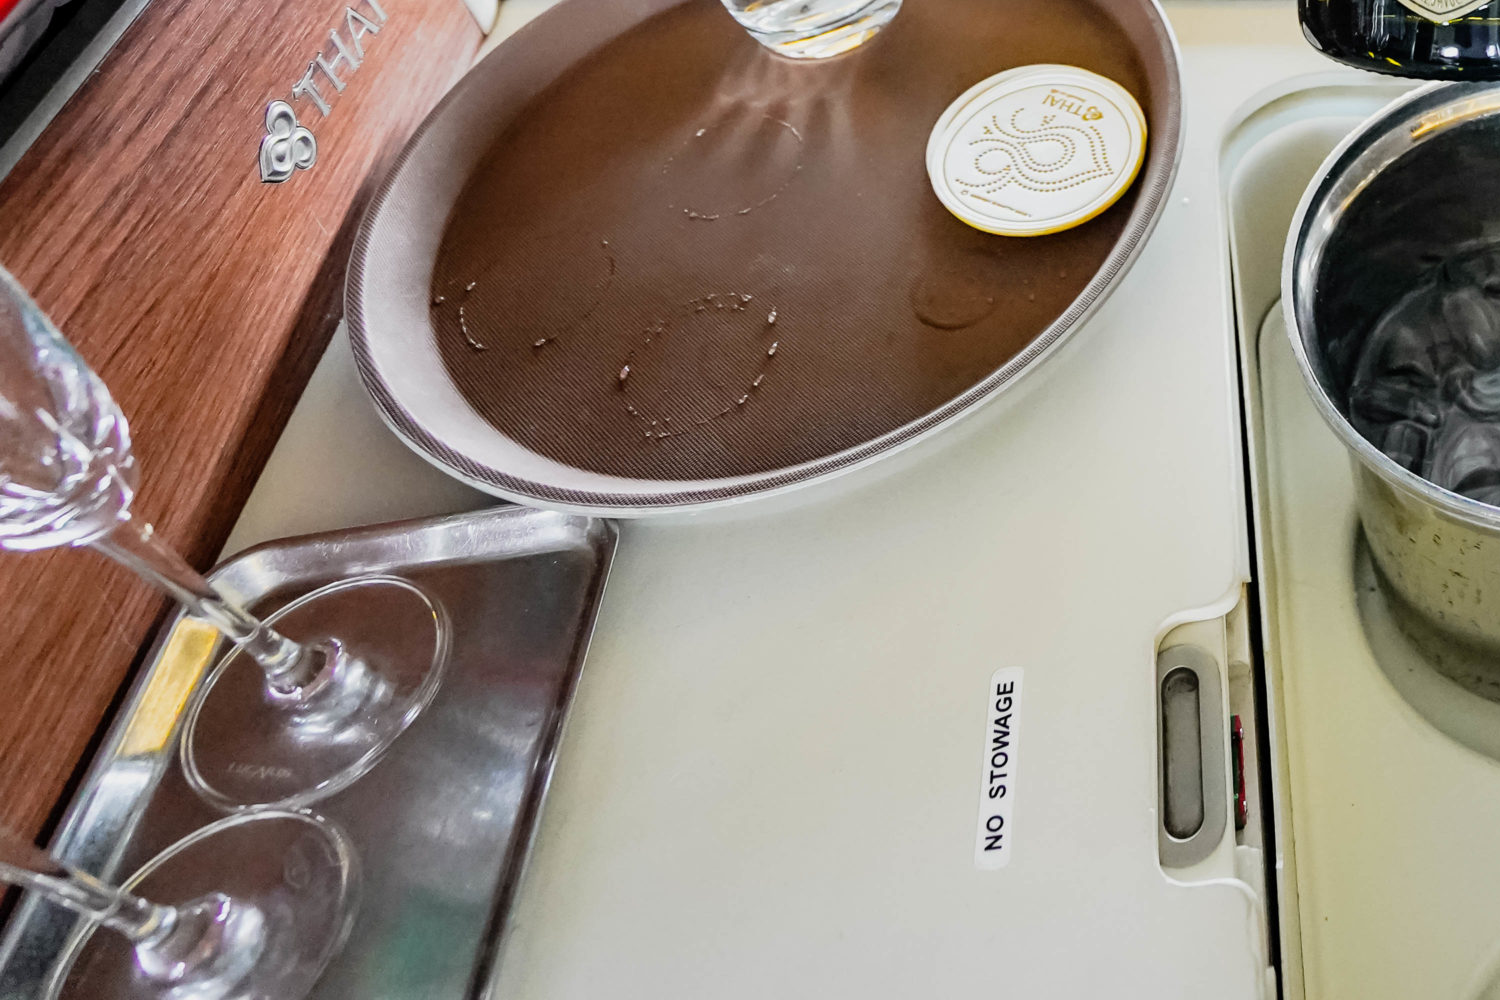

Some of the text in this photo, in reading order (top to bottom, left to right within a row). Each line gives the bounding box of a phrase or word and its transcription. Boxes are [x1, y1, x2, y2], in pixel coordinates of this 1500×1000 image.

[1041, 94, 1083, 116] THAI
[984, 681, 1014, 851] NO STOWAGE
